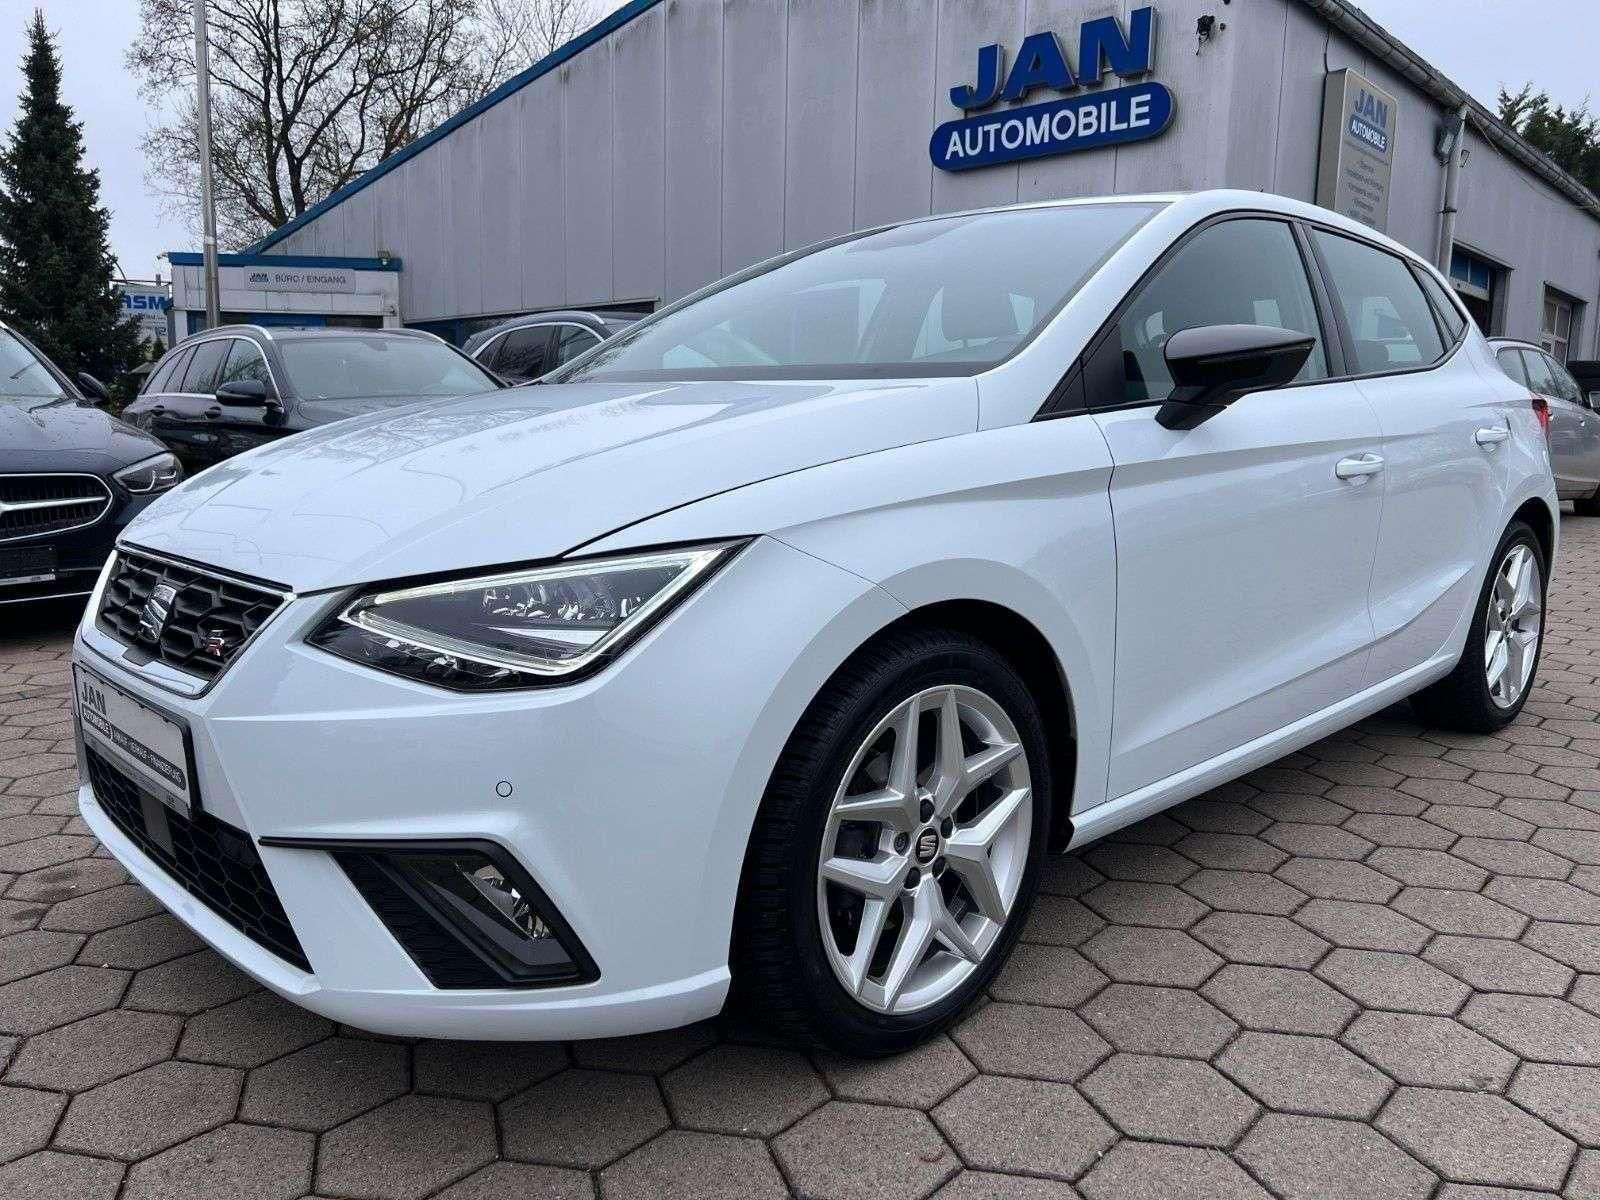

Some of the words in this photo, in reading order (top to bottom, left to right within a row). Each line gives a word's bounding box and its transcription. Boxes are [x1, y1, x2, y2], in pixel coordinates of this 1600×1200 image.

[950, 6, 1156, 110] JAN
[945, 93, 1151, 160] AUTOMOBILE
[1354, 88, 1388, 129] JAN
[275, 273, 300, 283] BÜRO
[306, 275, 346, 284] EINGANG
[81, 681, 107, 716] JAN
